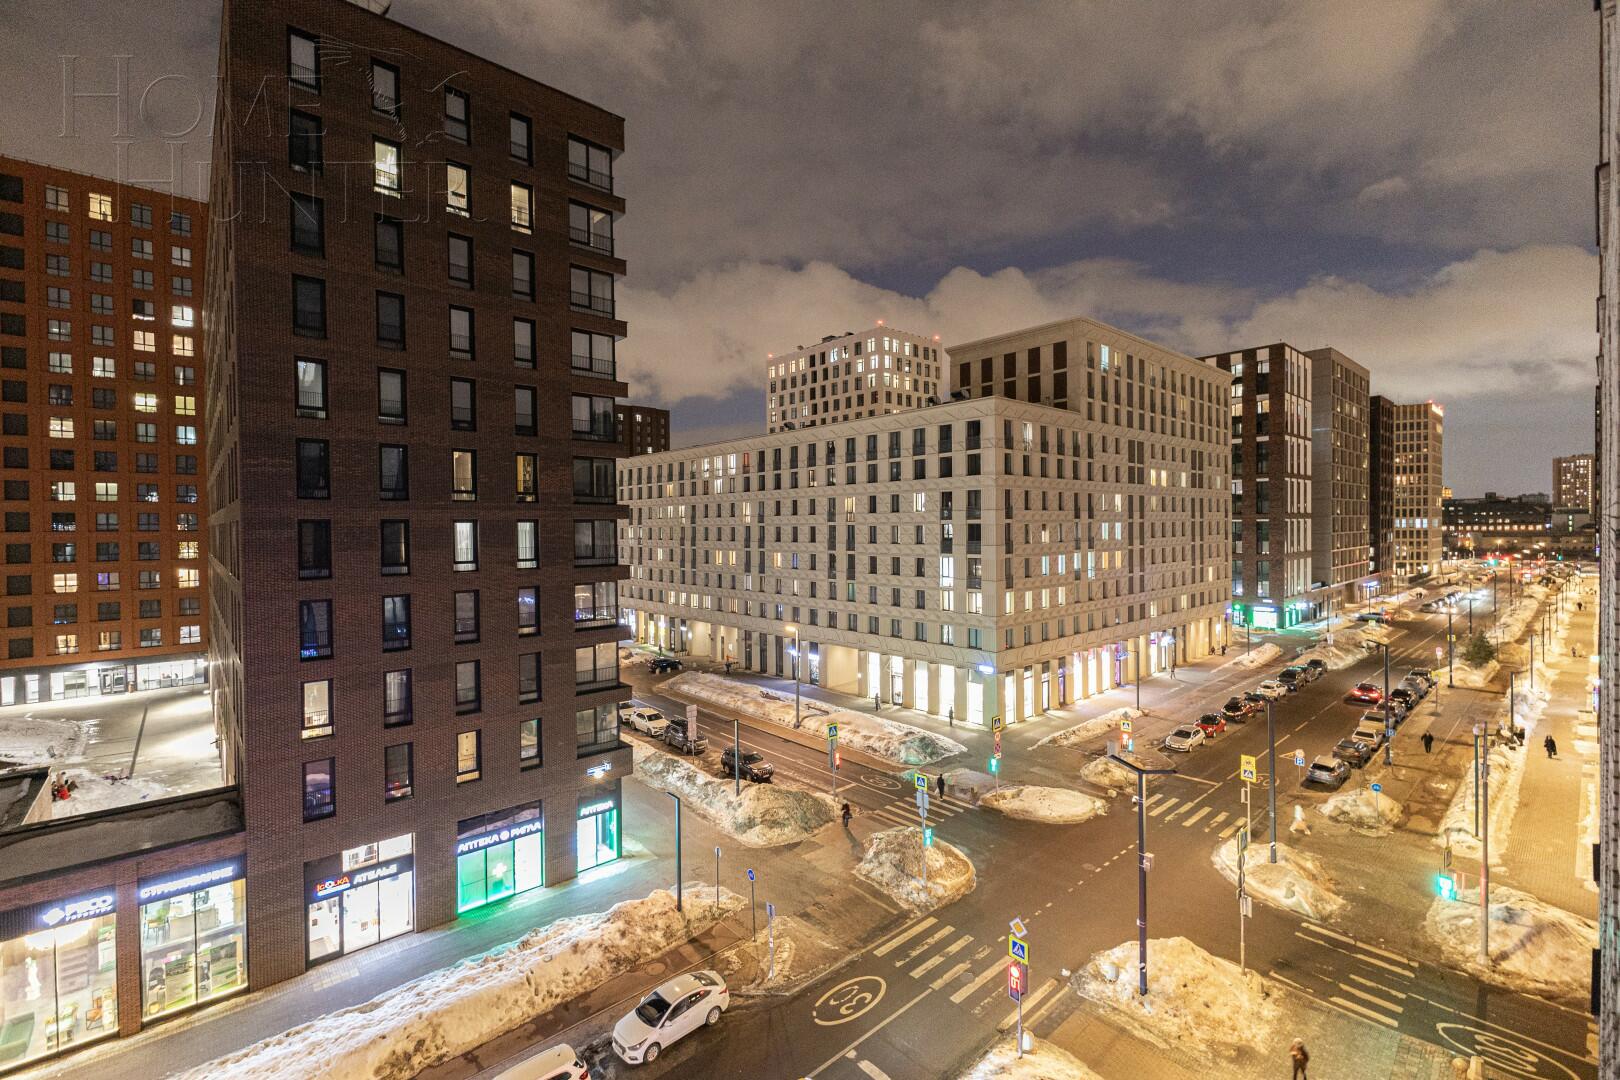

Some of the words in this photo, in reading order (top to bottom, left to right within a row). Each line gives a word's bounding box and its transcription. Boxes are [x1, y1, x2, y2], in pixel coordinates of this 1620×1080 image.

[457, 833, 500, 854] АПТЕКА
[510, 821, 542, 838] РИГЛА
[353, 864, 398, 885] АТЕЛЬЕ
[828, 984, 873, 1016] 30
